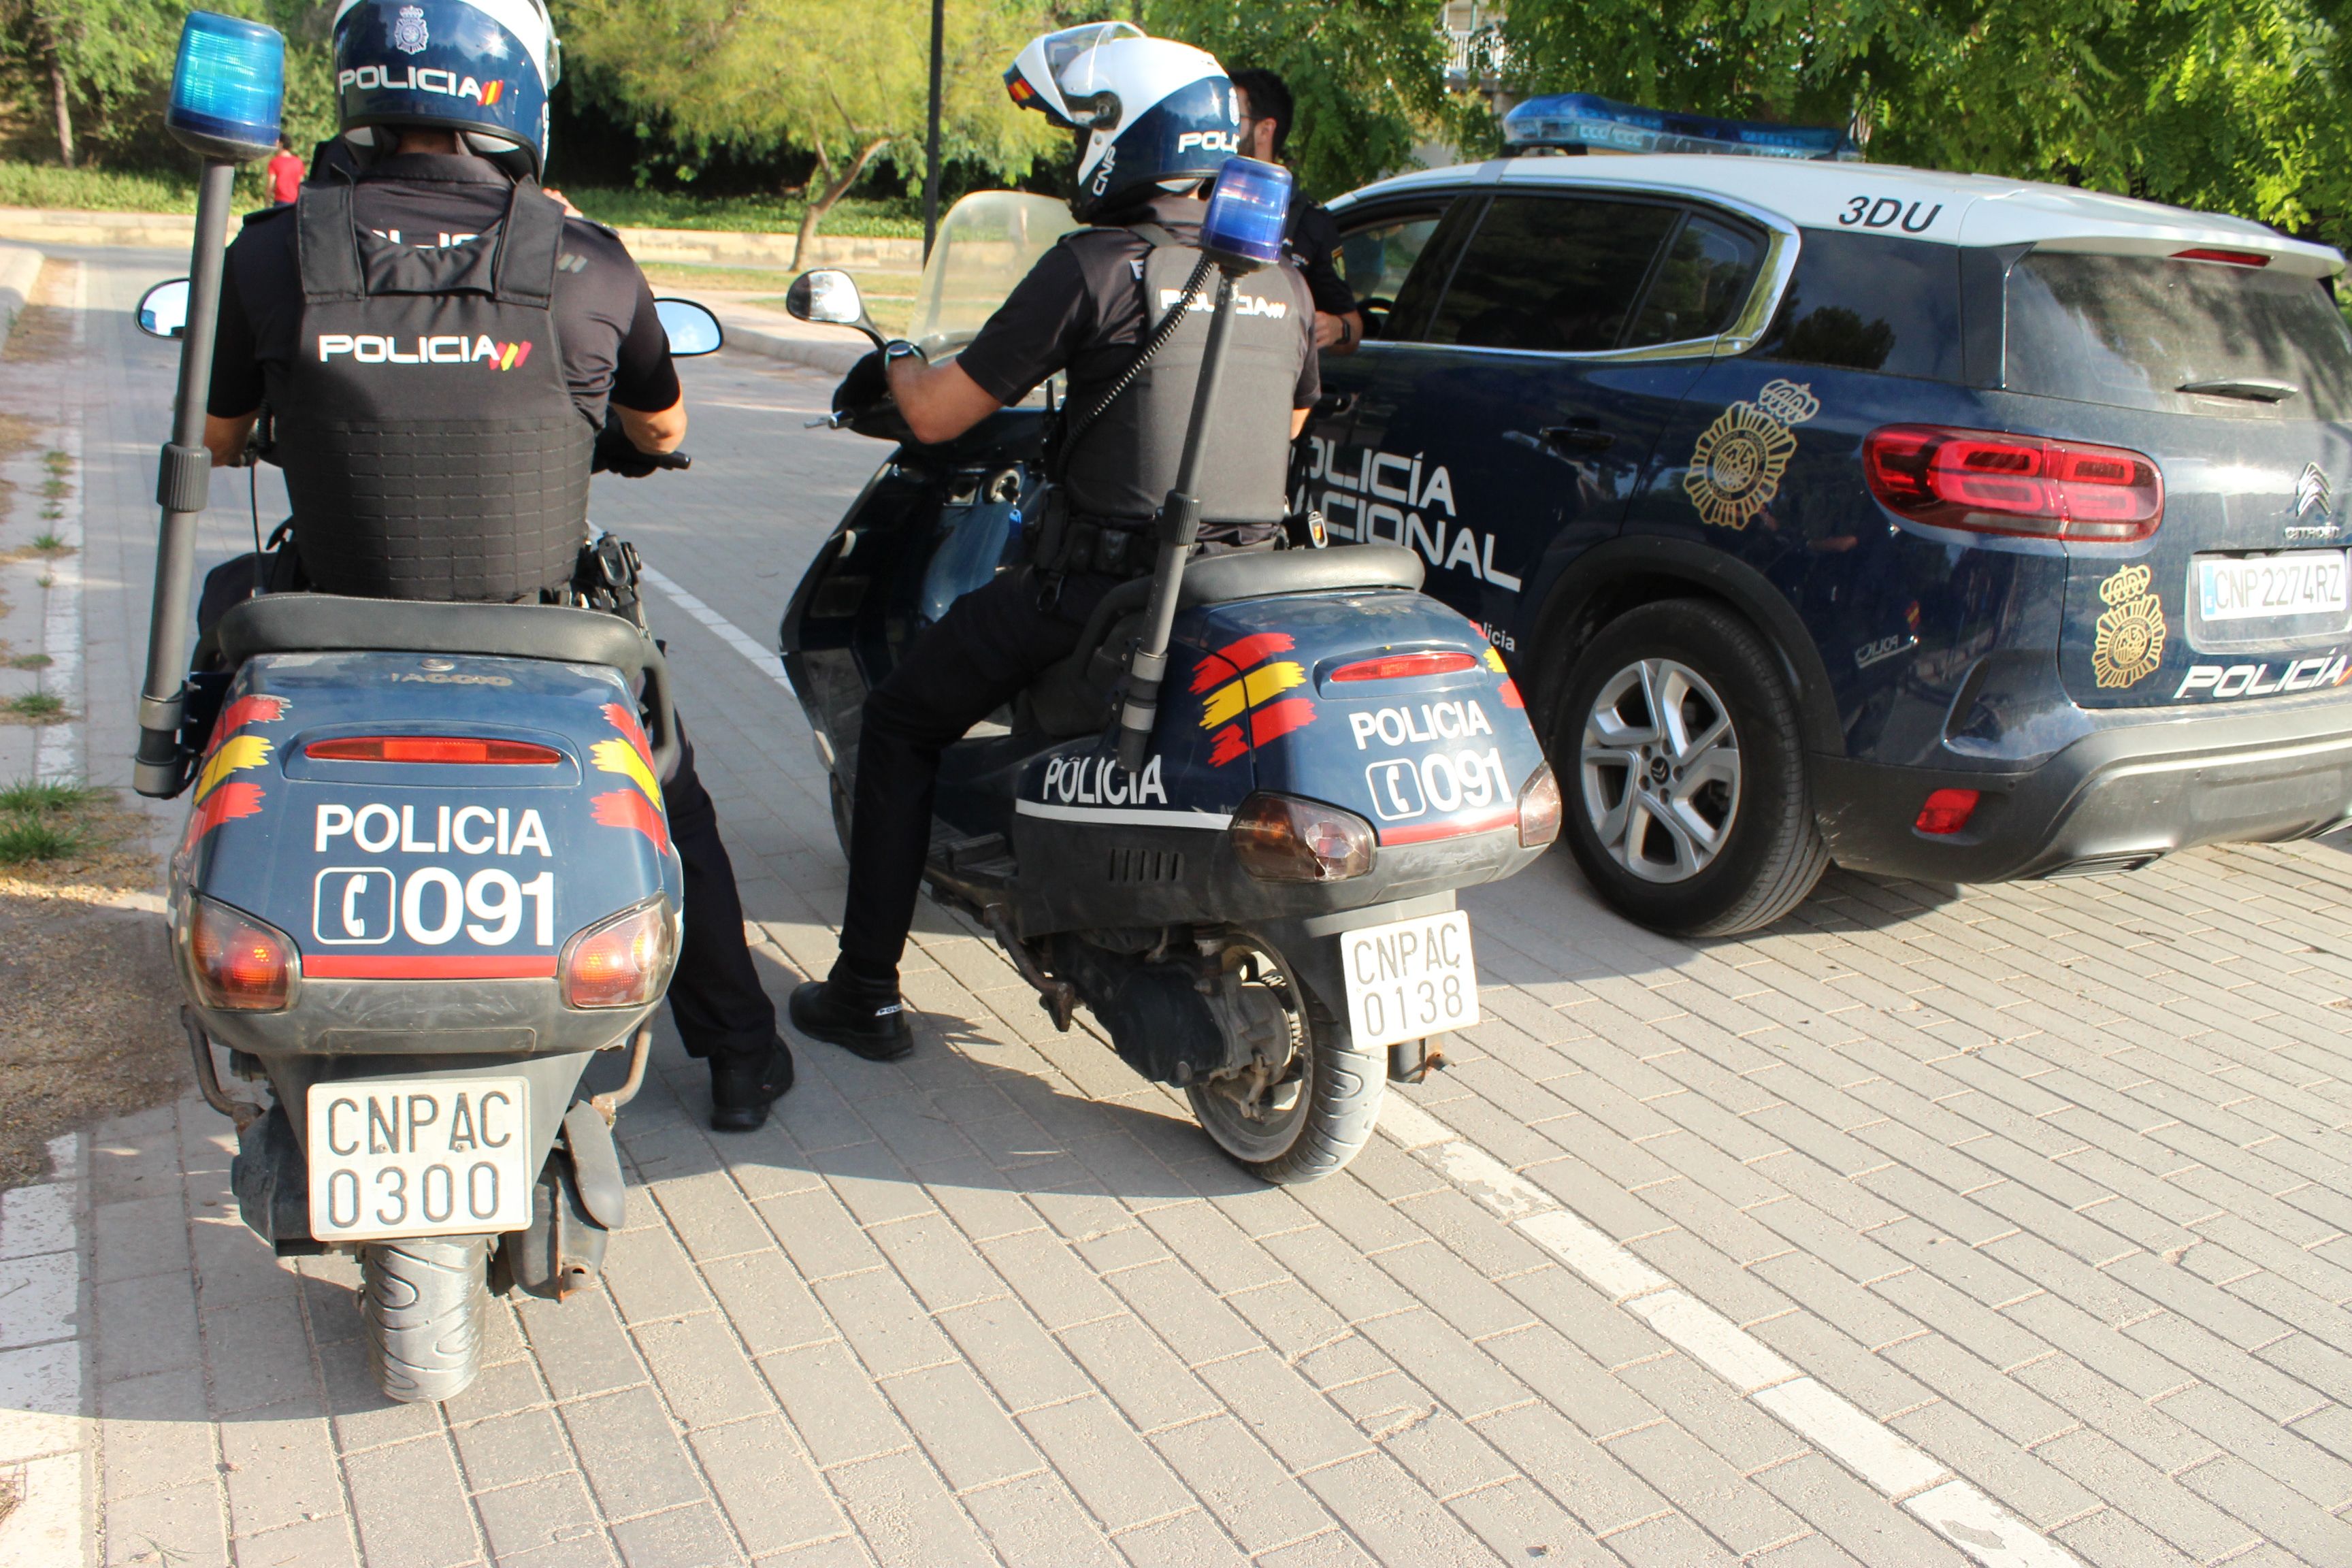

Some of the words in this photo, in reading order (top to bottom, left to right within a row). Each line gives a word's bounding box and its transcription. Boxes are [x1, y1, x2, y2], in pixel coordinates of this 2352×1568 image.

[338, 65, 482, 101] POLICIA
[1092, 146, 1116, 196] CNP
[1839, 196, 1943, 233] 3DU
[318, 335, 500, 363] POLICIA
[1291, 436, 1456, 517] OLICÍA
[1484, 622, 1515, 652] licia
[2173, 647, 2347, 699] POLICÍA
[1348, 700, 1492, 750] POLICIA
[1043, 755, 1168, 805] POLICIA
[1421, 747, 1512, 812] 091
[314, 804, 553, 857] POLICIA
[402, 867, 554, 946] 091
[1364, 975, 1463, 1036] 0138
[329, 1161, 499, 1228] 0300
